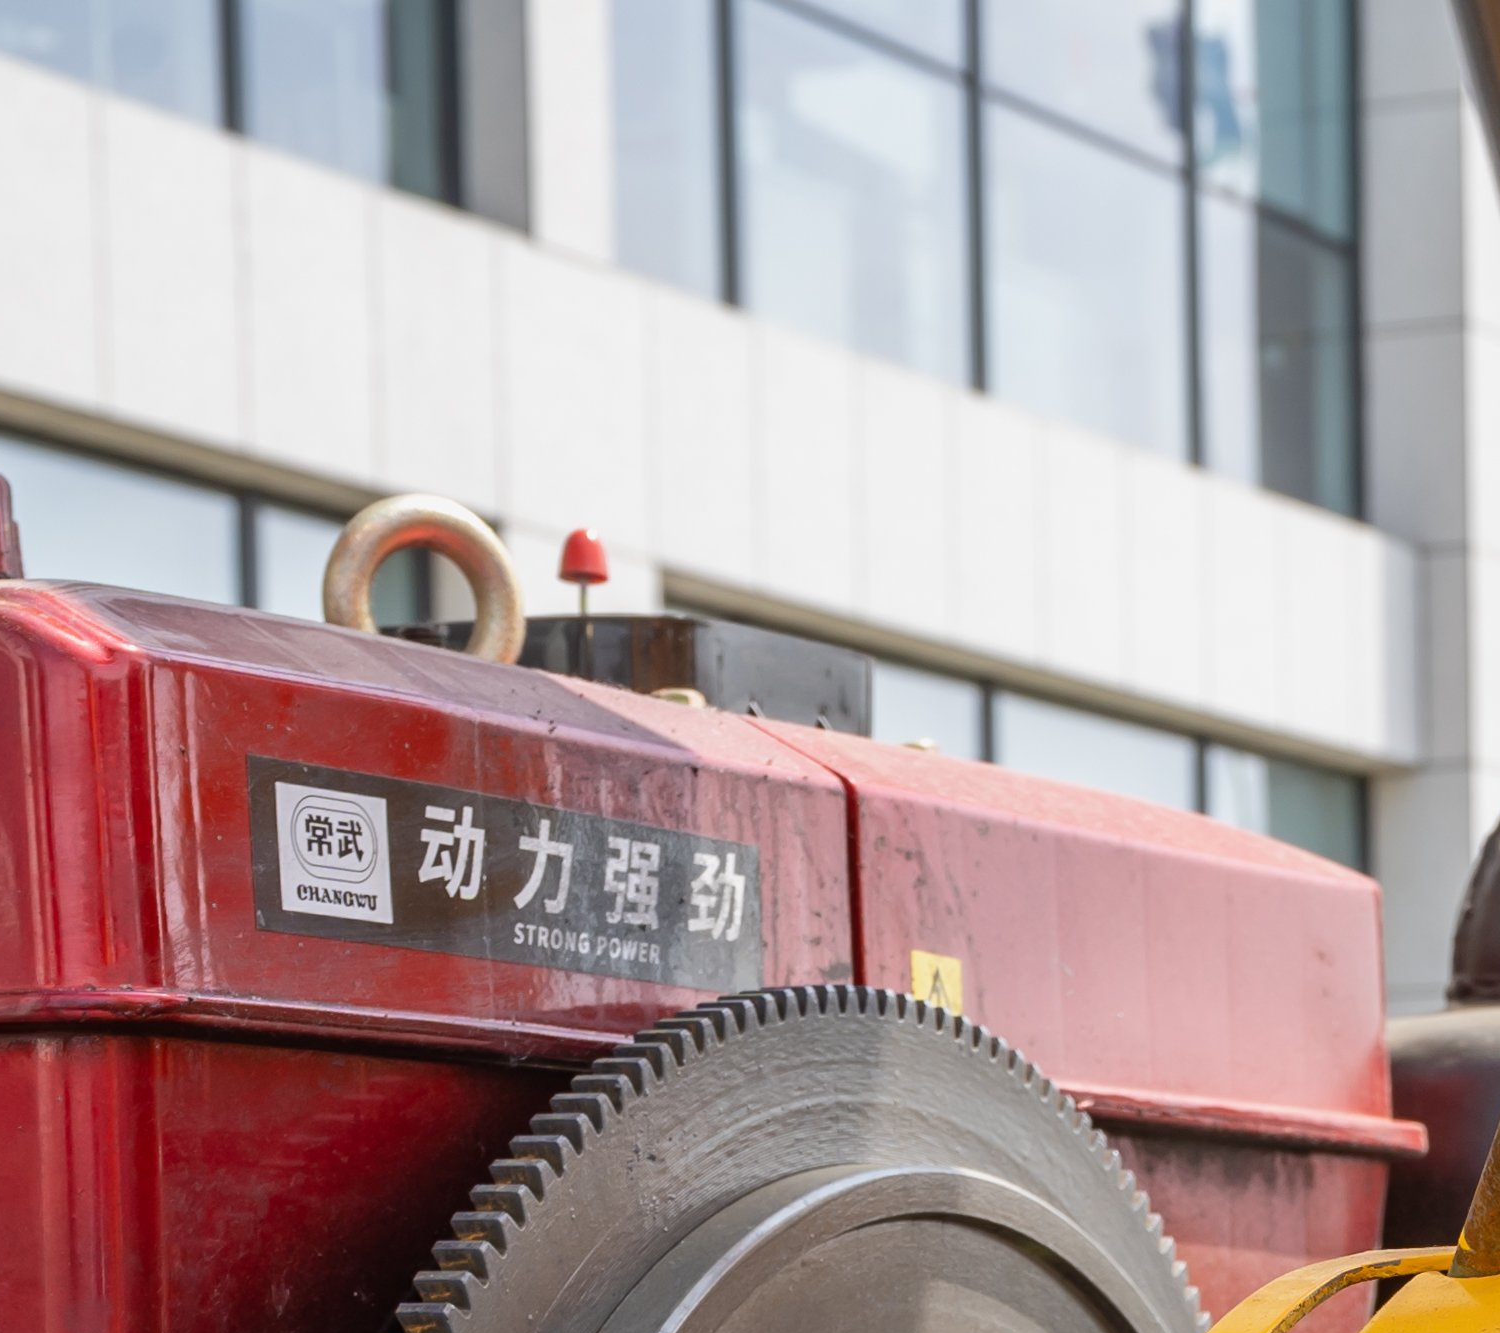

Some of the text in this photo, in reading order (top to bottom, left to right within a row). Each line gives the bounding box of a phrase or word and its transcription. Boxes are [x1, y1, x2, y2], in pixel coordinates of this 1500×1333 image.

[304, 814, 365, 864] 常武
[418, 804, 746, 942] 动力强劲
[296, 884, 378, 911] CHANGWU
[513, 922, 662, 965] STRONG POWER
